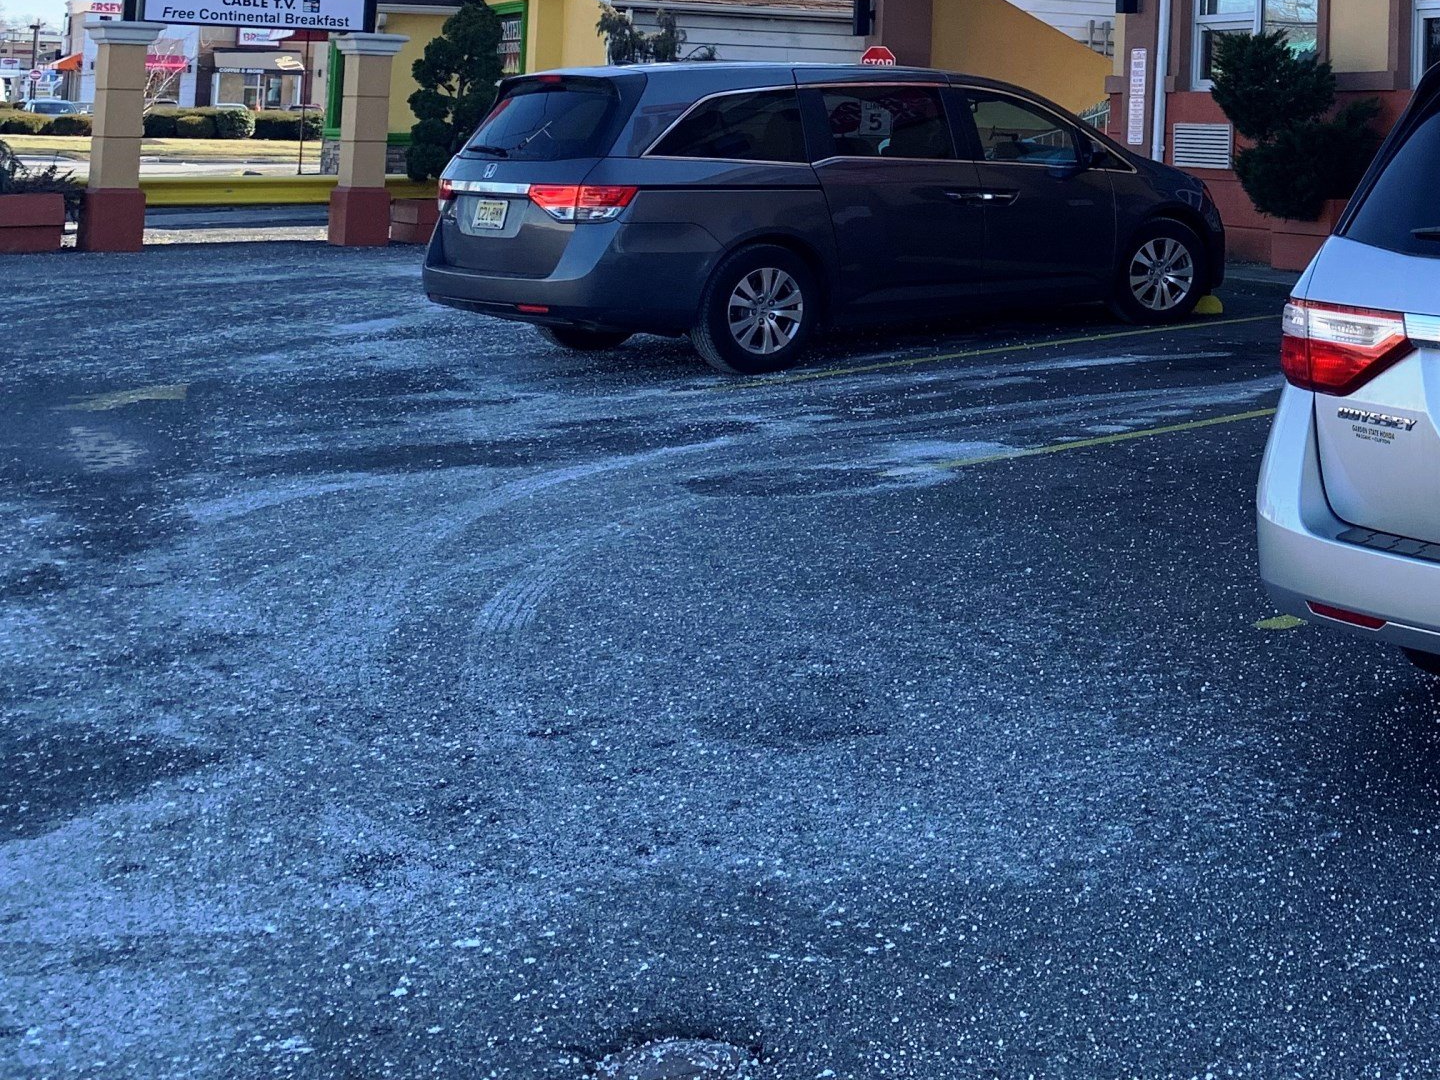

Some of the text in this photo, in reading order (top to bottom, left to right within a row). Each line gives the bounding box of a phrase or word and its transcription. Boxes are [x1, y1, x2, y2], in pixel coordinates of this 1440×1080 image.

[90, 2, 123, 12] ERSEY
[162, 6, 350, 27] Free Continental Breakfast
[869, 113, 881, 130] 5
[1338, 407, 1418, 431] ODYSSEY
